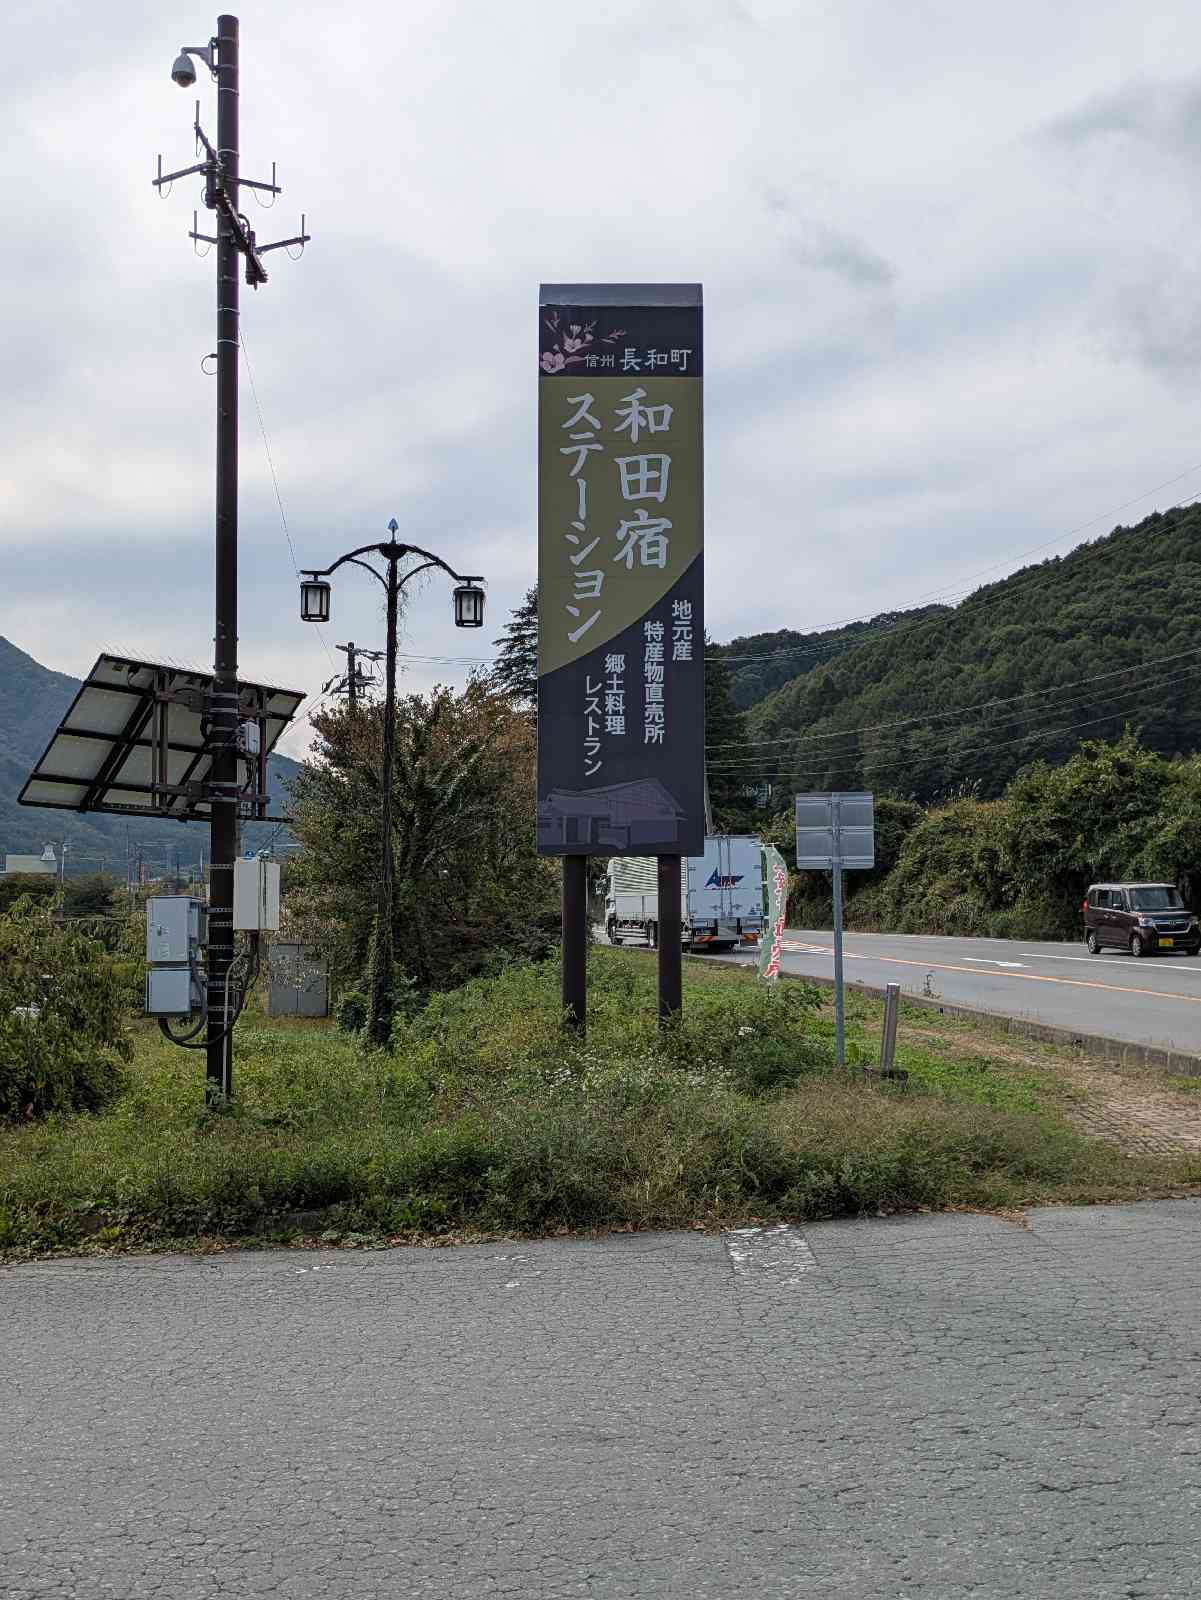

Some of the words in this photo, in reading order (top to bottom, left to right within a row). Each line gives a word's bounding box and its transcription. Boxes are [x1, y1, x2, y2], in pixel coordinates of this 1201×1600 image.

[584, 354, 615, 368] 信州
[619, 348, 693, 371] 長和町
[613, 387, 674, 570] 和田宿
[672, 599, 693, 661] 地元産
[583, 675, 603, 776] レストラン
[604, 653, 626, 735] 郷土料理
[644, 620, 665, 744] 特産物直売所
